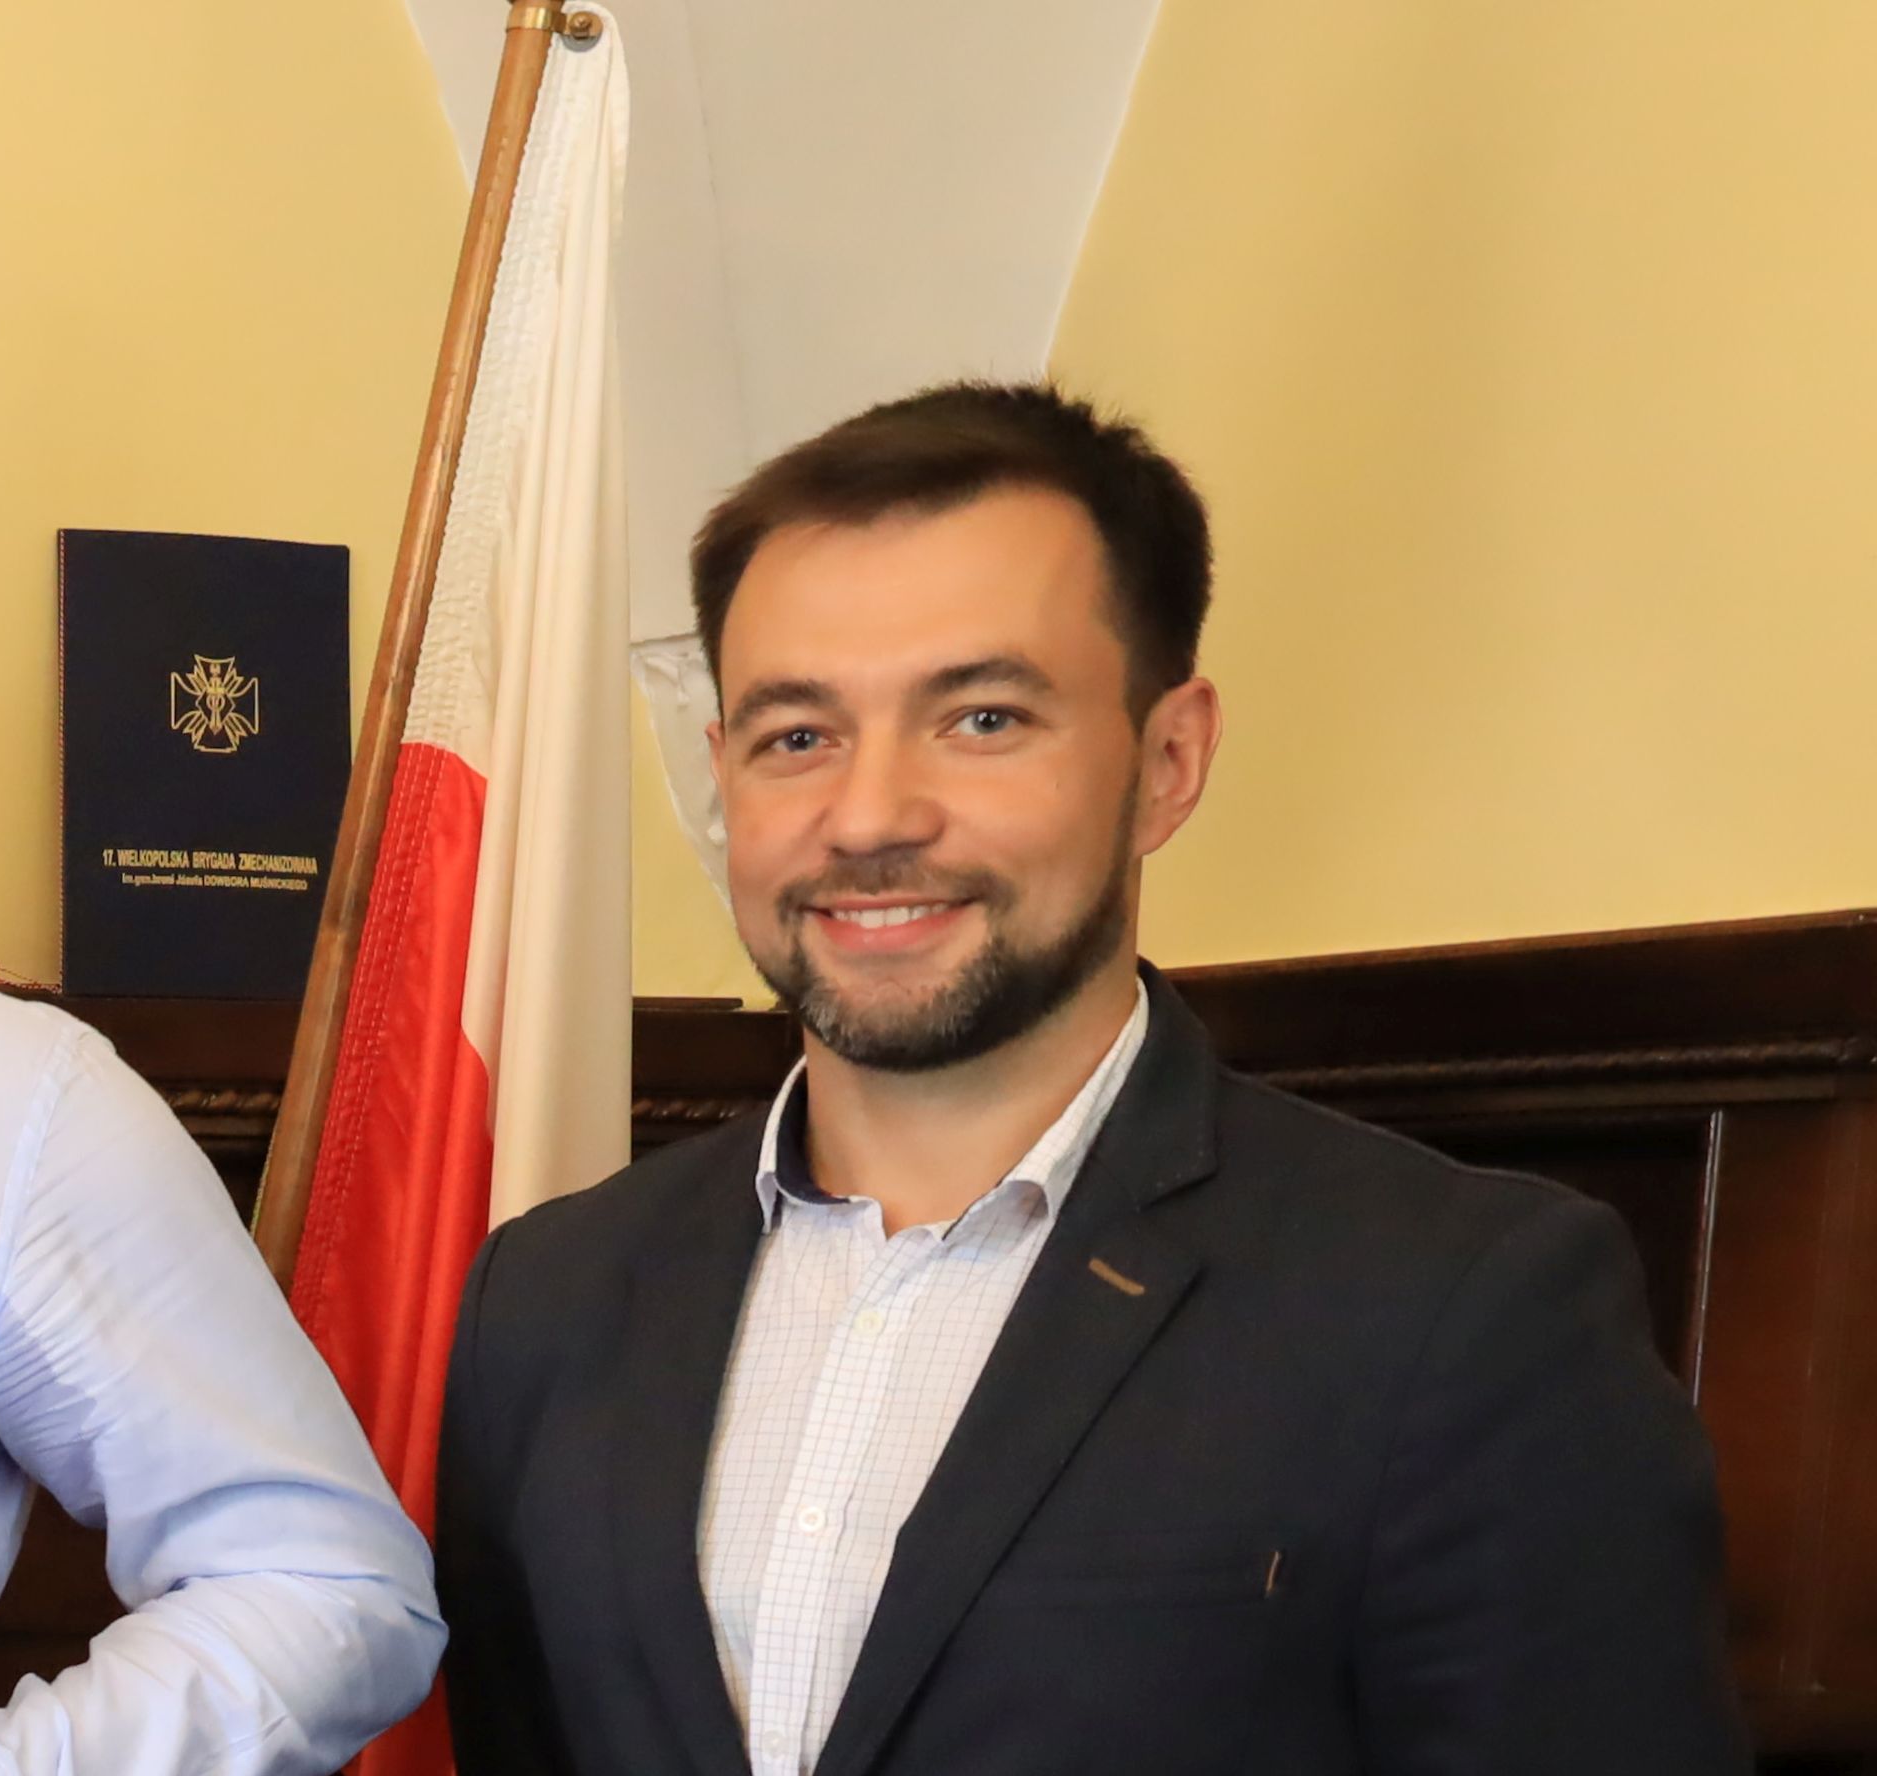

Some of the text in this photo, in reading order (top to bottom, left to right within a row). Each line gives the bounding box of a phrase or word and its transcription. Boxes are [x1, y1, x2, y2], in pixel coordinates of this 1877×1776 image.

[103, 850, 318, 874] 17. WIELKOPOLSKA BRYGADA ZMECHANIZOWANA
